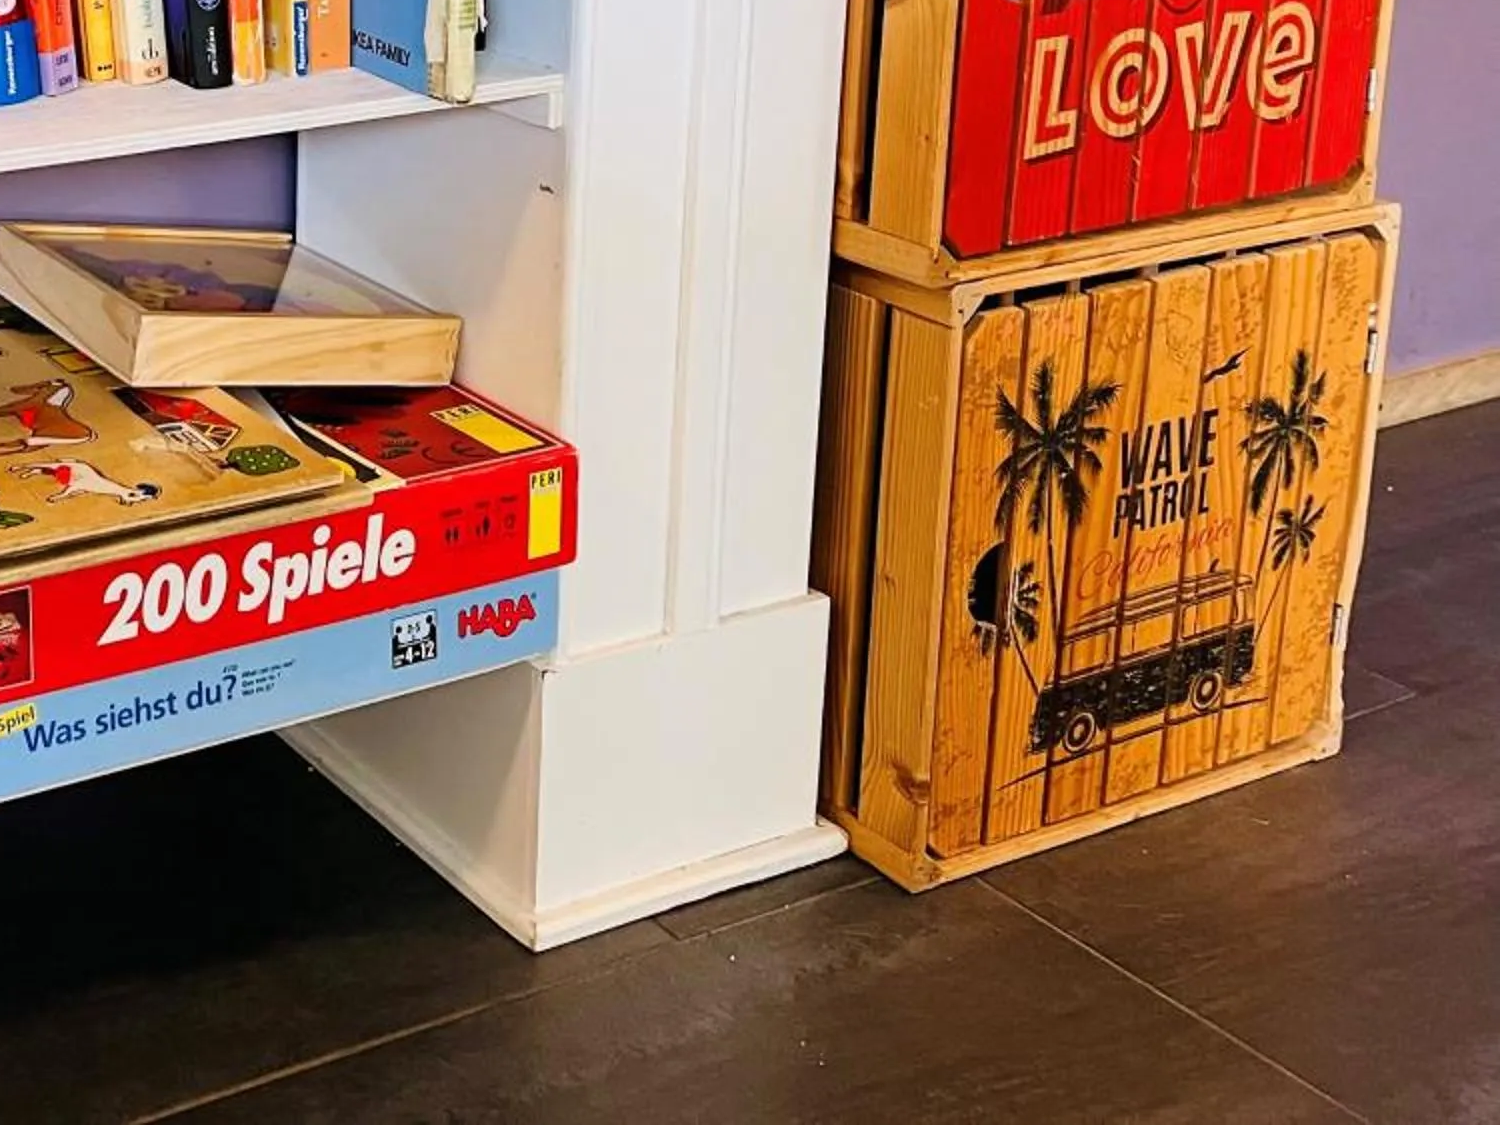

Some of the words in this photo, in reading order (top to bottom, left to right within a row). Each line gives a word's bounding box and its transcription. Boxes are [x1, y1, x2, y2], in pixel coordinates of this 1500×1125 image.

[373, 35, 412, 68] FAMILY
[531, 470, 562, 490] PERI
[1119, 408, 1221, 489] WAVE
[1112, 472, 1212, 540] PATROL
[96, 553, 228, 646] 200
[237, 512, 417, 625] Spiele
[1078, 515, 1237, 602] California
[457, 594, 536, 639] HABA
[23, 725, 87, 753] Was
[95, 691, 178, 735] siehst
[186, 674, 238, 711] du?
